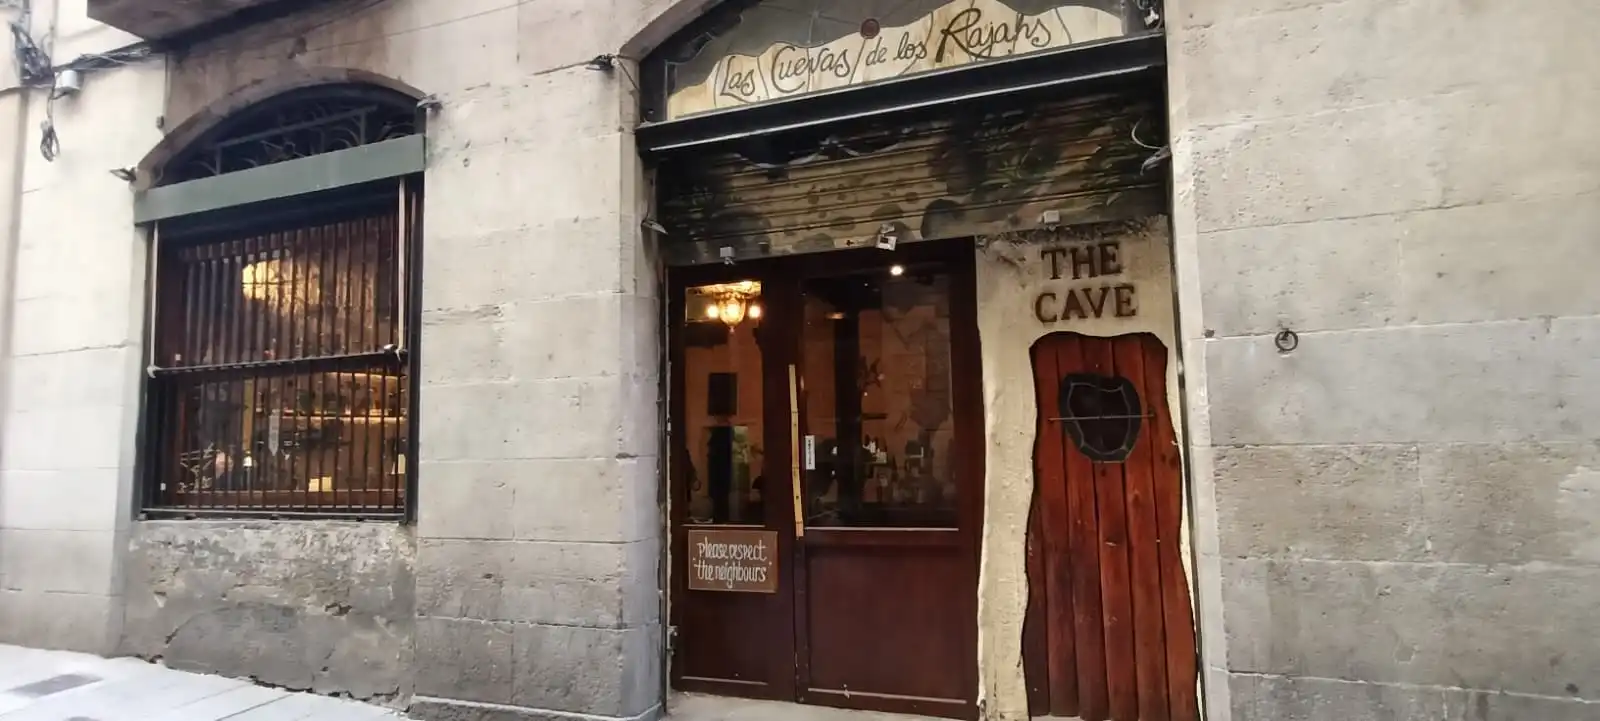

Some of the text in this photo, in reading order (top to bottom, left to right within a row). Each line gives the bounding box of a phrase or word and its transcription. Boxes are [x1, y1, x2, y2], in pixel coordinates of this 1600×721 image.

[720, 8, 1051, 102] Las Cuevas de los Rajahs
[1040, 242, 1123, 280] THE
[1034, 285, 1136, 323] CAVE
[696, 536, 768, 561] please respect
[715, 561, 767, 589] neighbours
